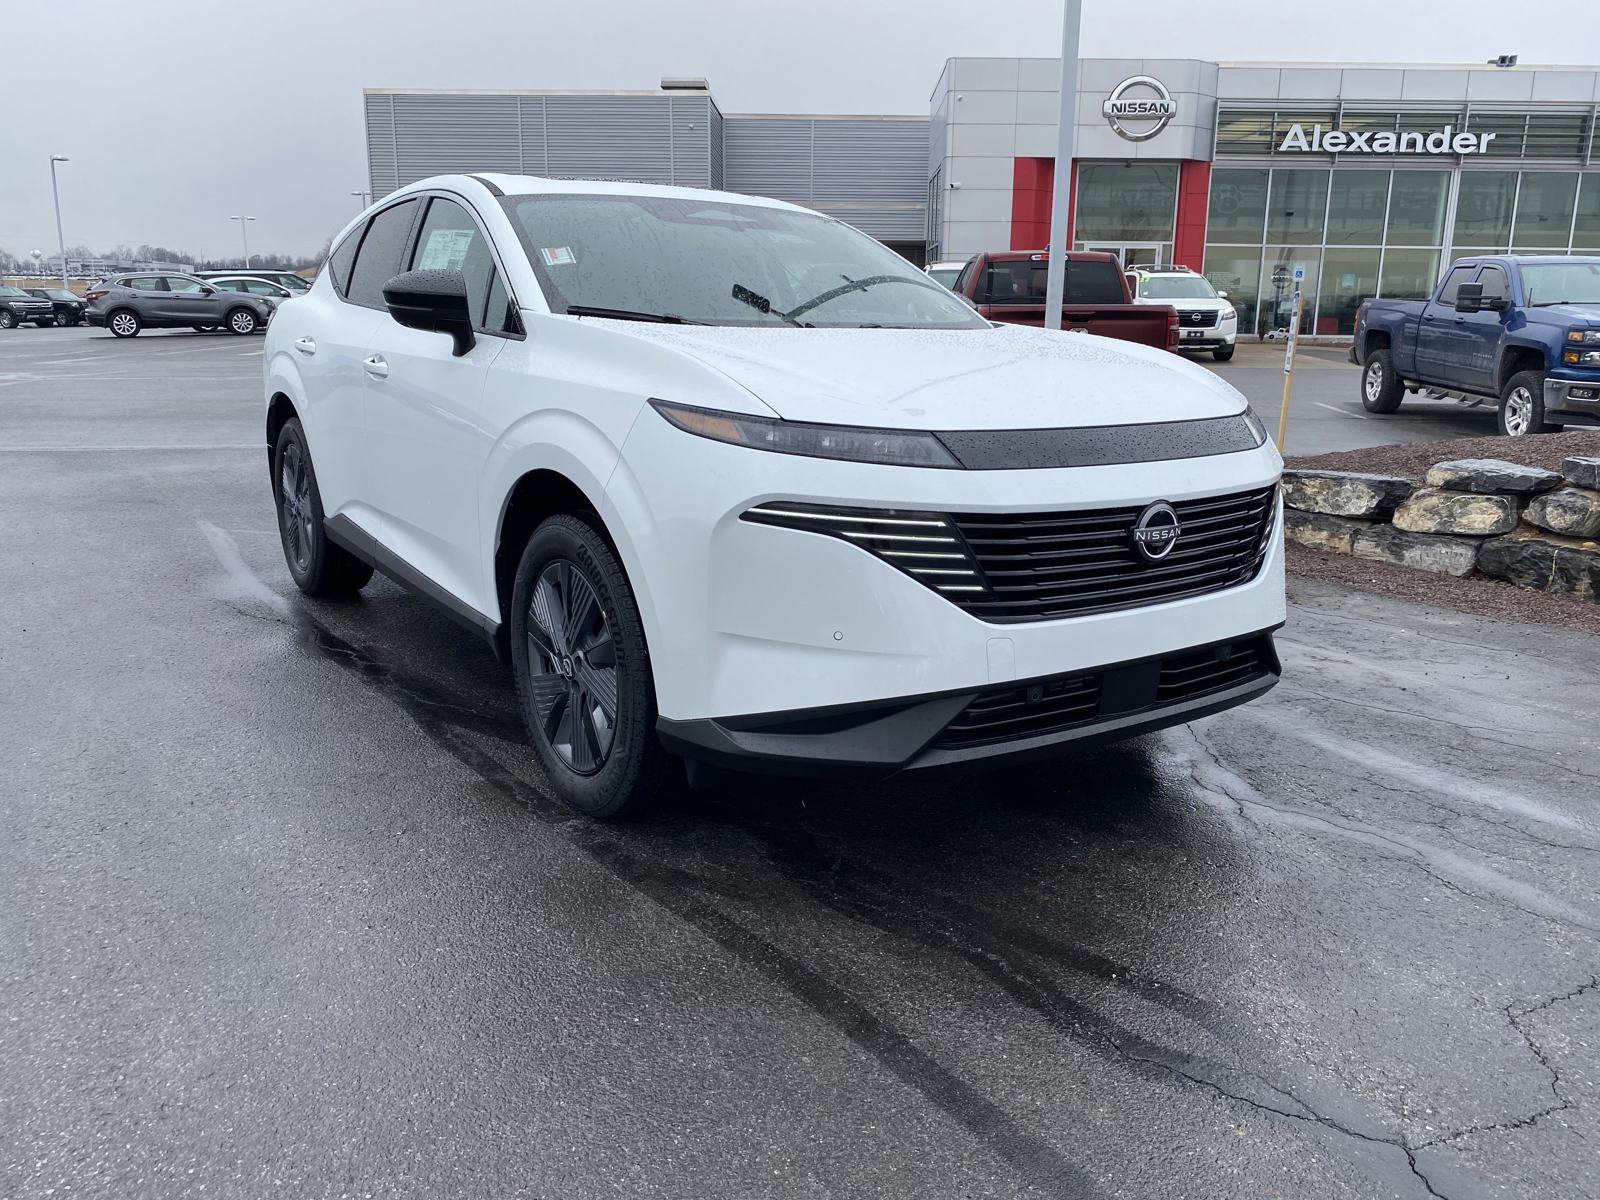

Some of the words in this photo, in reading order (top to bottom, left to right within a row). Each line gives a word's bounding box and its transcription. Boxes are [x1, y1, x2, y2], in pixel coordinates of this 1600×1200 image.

[1111, 102, 1170, 114] NISSAN
[1278, 123, 1496, 154] Alexander
[1136, 527, 1181, 540] NISSAN
